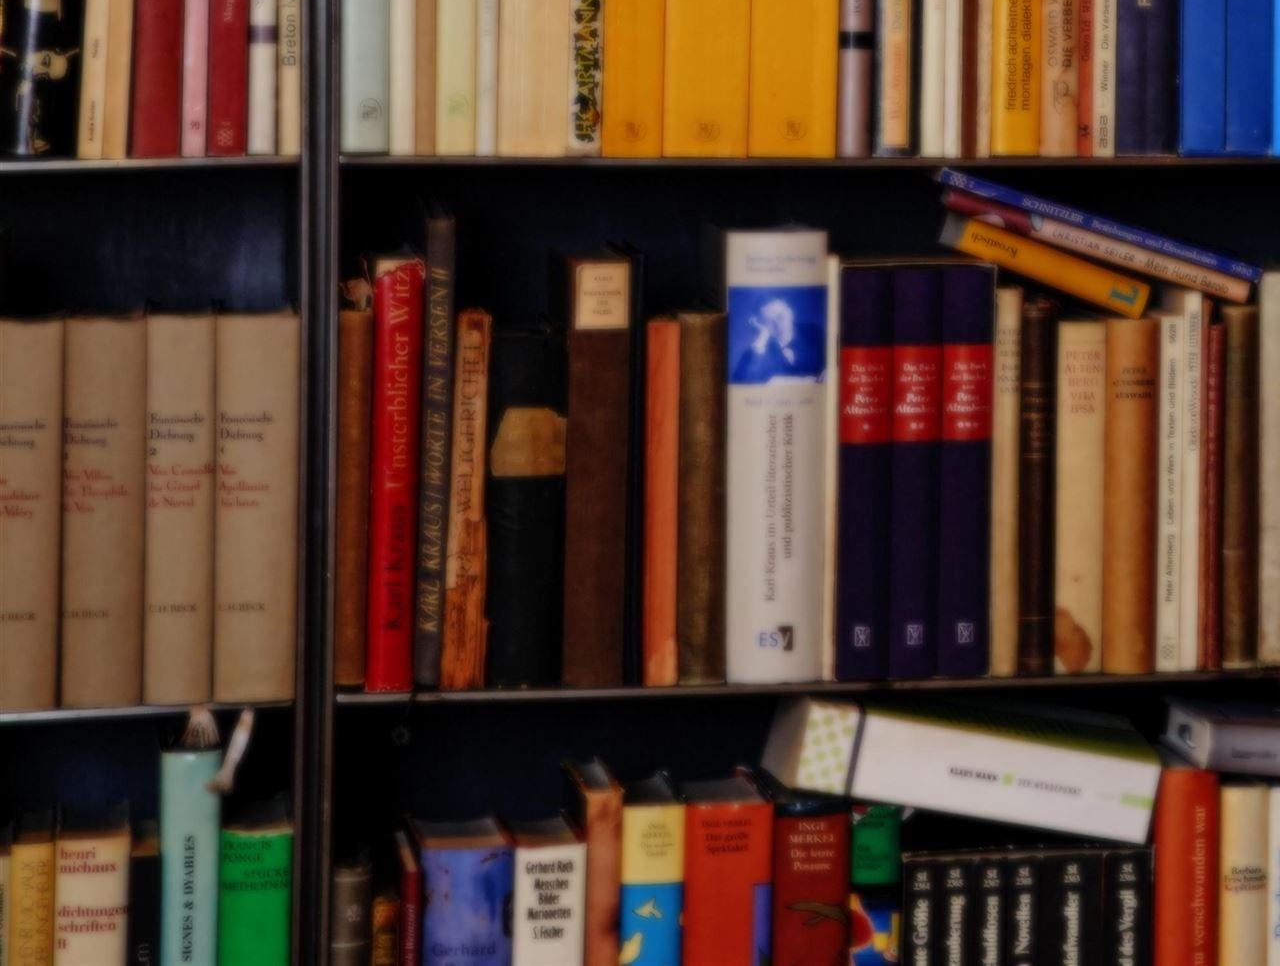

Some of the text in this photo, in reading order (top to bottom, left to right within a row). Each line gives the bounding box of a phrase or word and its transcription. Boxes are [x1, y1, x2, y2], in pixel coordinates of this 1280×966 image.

[281, 13, 297, 66] Breton
[1062, 46, 1074, 70] DIE
[1004, 60, 1019, 113] friedrich
[384, 332, 409, 490] Unsterblicher
[781, 413, 795, 447] Kritik
[781, 535, 795, 560] und
[59, 846, 97, 861] henri
[184, 834, 196, 897] DYABLES
[57, 919, 116, 934] schriften
[181, 916, 194, 964] SIGNES
